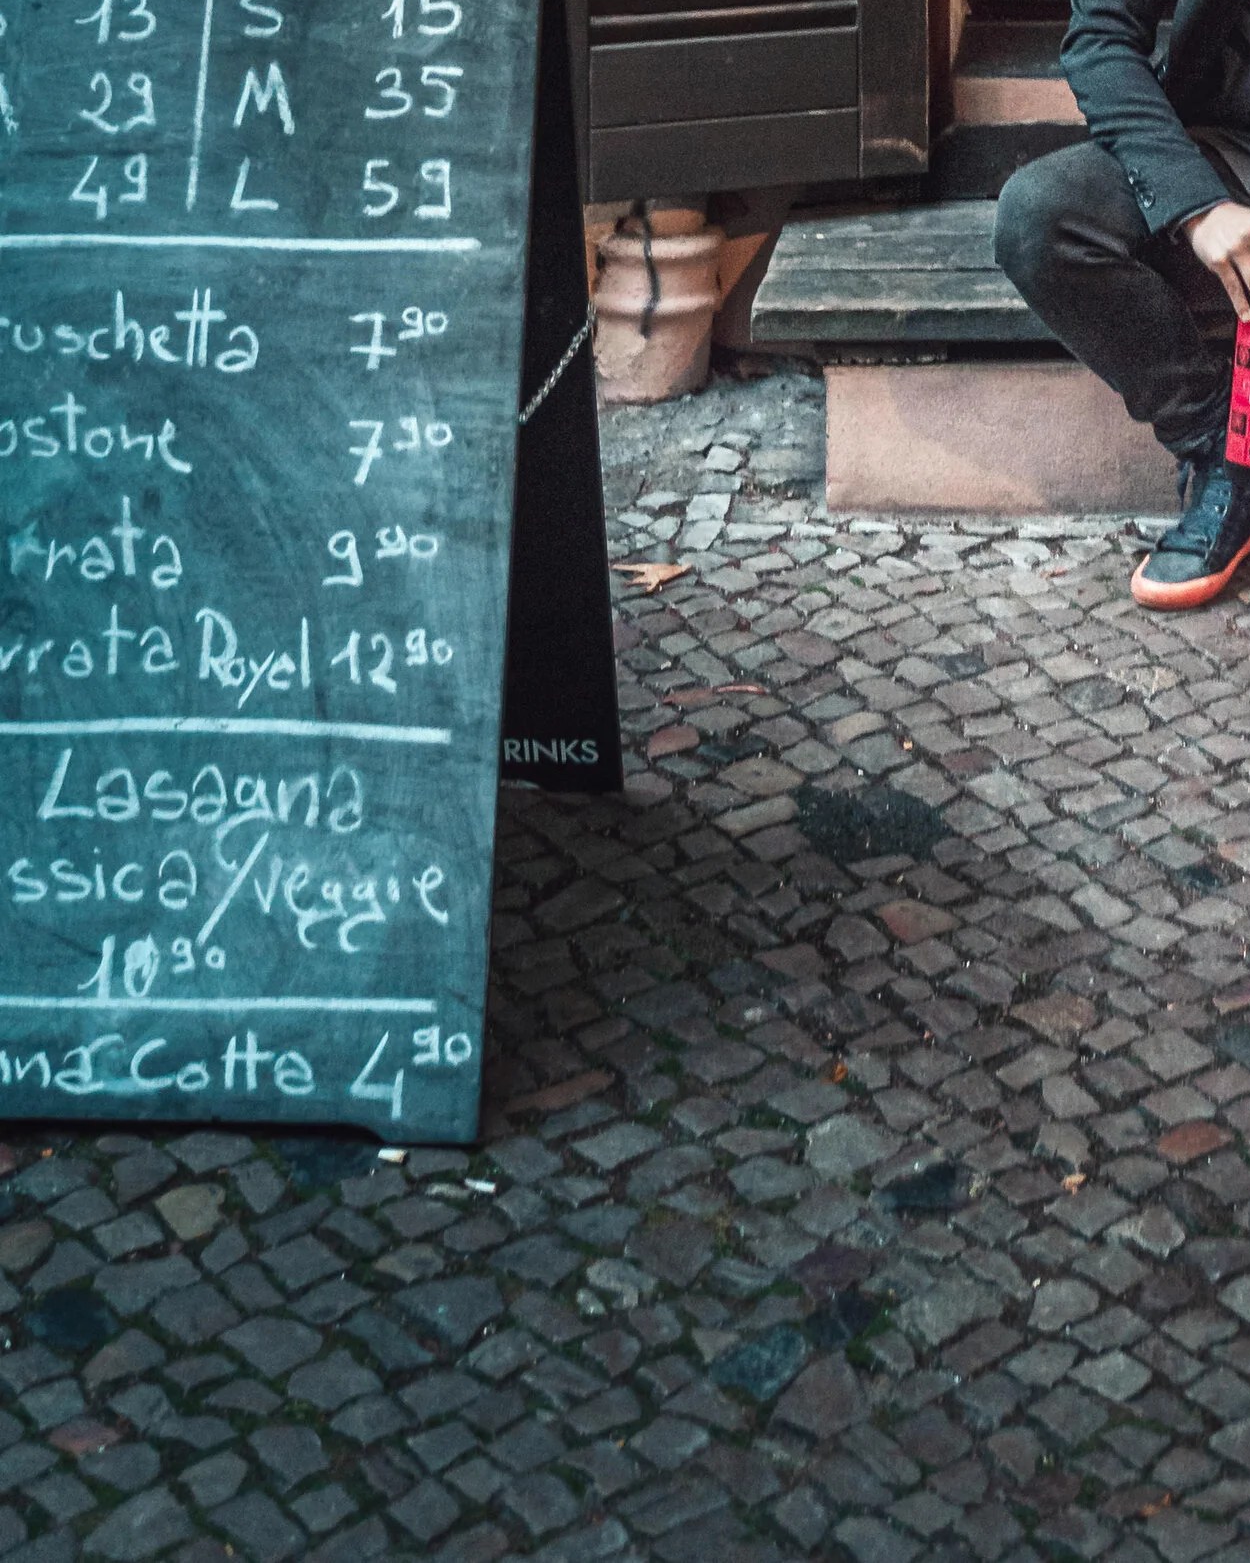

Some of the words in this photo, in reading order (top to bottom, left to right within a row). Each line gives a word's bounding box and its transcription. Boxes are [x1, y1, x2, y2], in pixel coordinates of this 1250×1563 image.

[77, 72, 157, 133] 29
[233, 62, 295, 135] M
[364, 66, 464, 120] 35
[68, 154, 148, 219] 49
[230, 157, 279, 211] L
[362, 159, 452, 218] 59
[36, 748, 364, 870] Lasagna
[129, 1030, 316, 1095] Cotta
